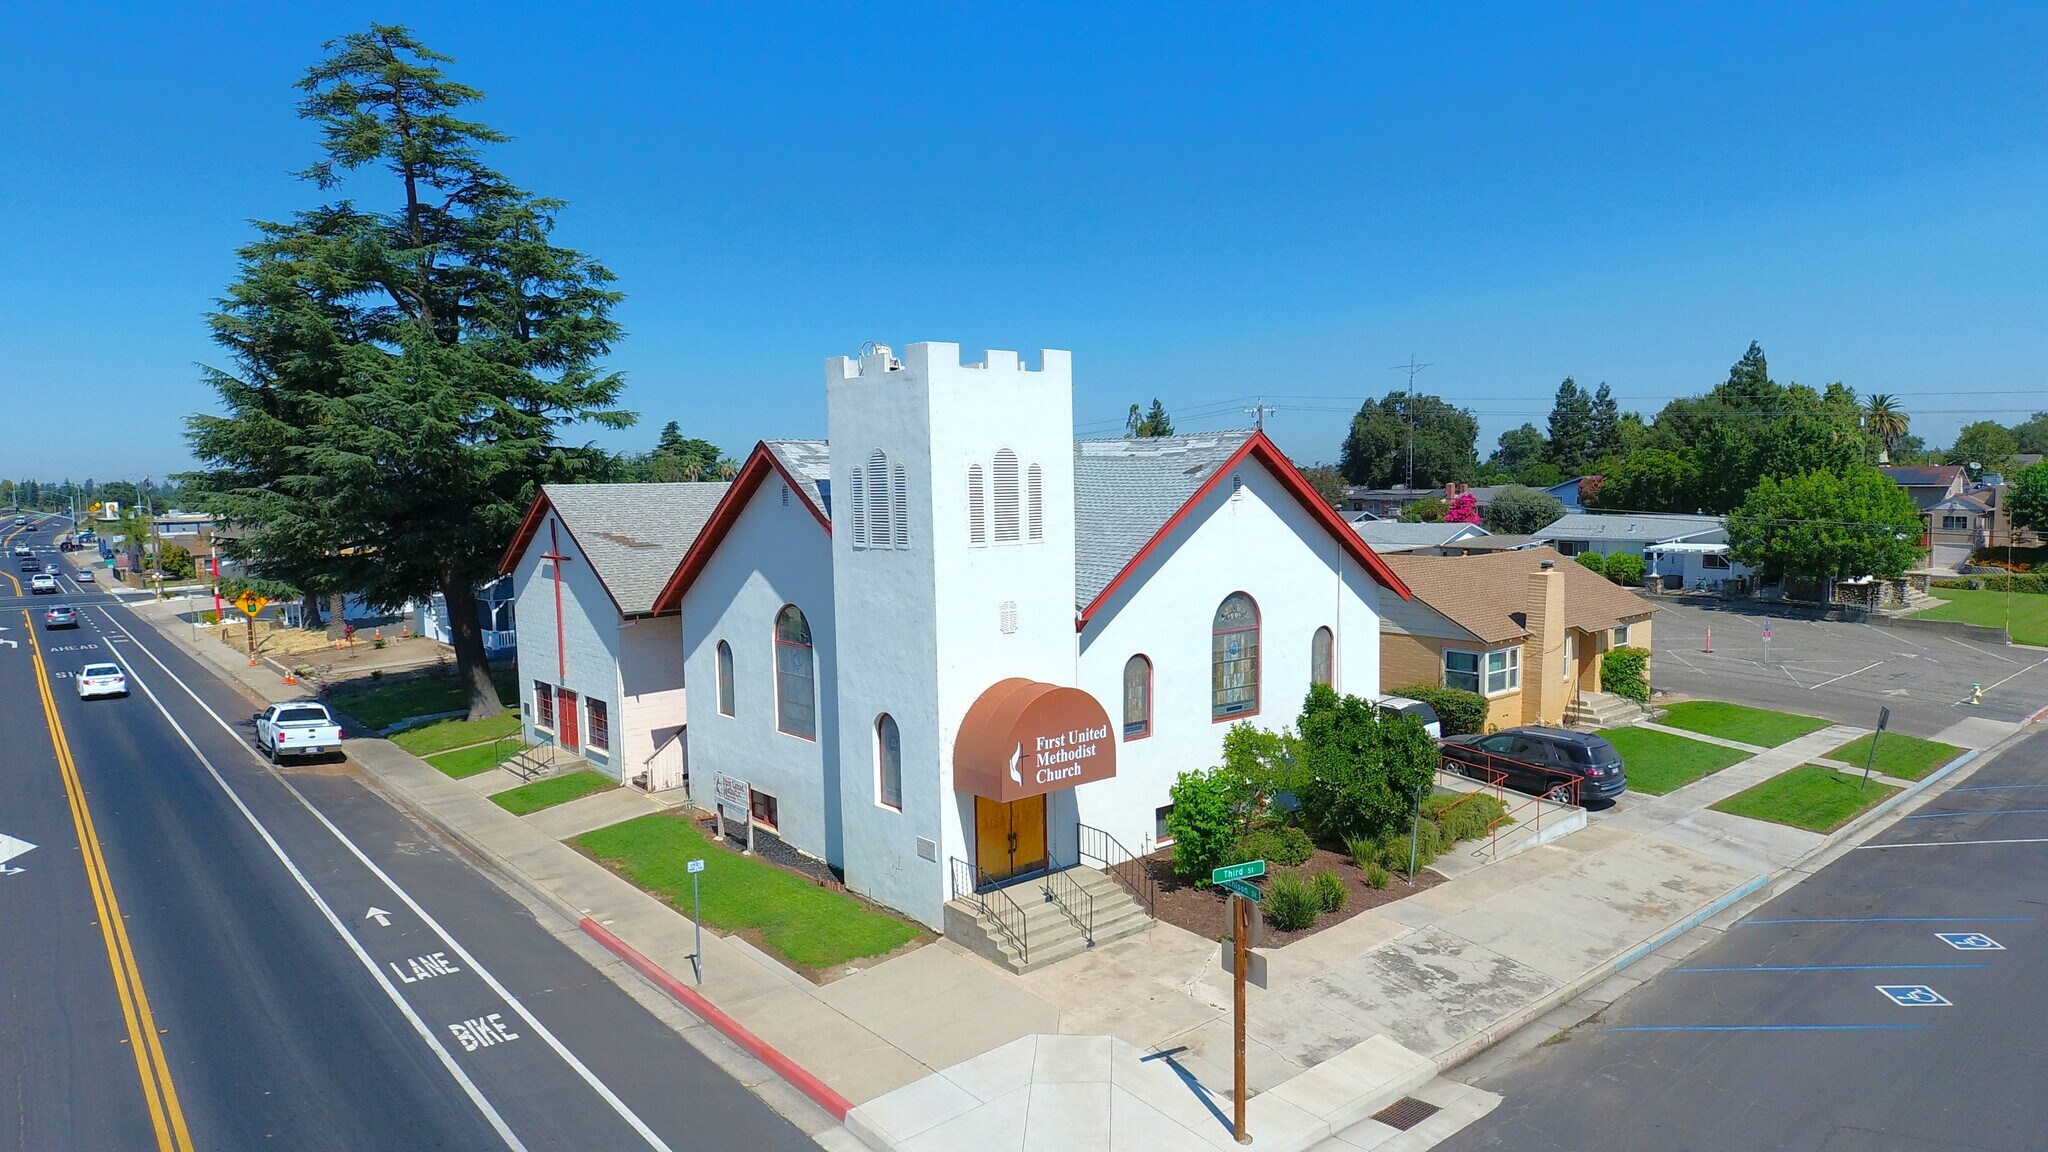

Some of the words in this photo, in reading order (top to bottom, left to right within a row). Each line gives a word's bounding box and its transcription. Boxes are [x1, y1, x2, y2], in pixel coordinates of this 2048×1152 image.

[50, 643, 99, 653] AHEAD
[1036, 734, 1066, 751] First
[1068, 725, 1107, 744] United
[1036, 743, 1097, 768] Methodist
[1036, 762, 1082, 784] Church
[1224, 868, 1243, 879] Third
[389, 952, 460, 984] LANE
[448, 1013, 519, 1052] BIKE
